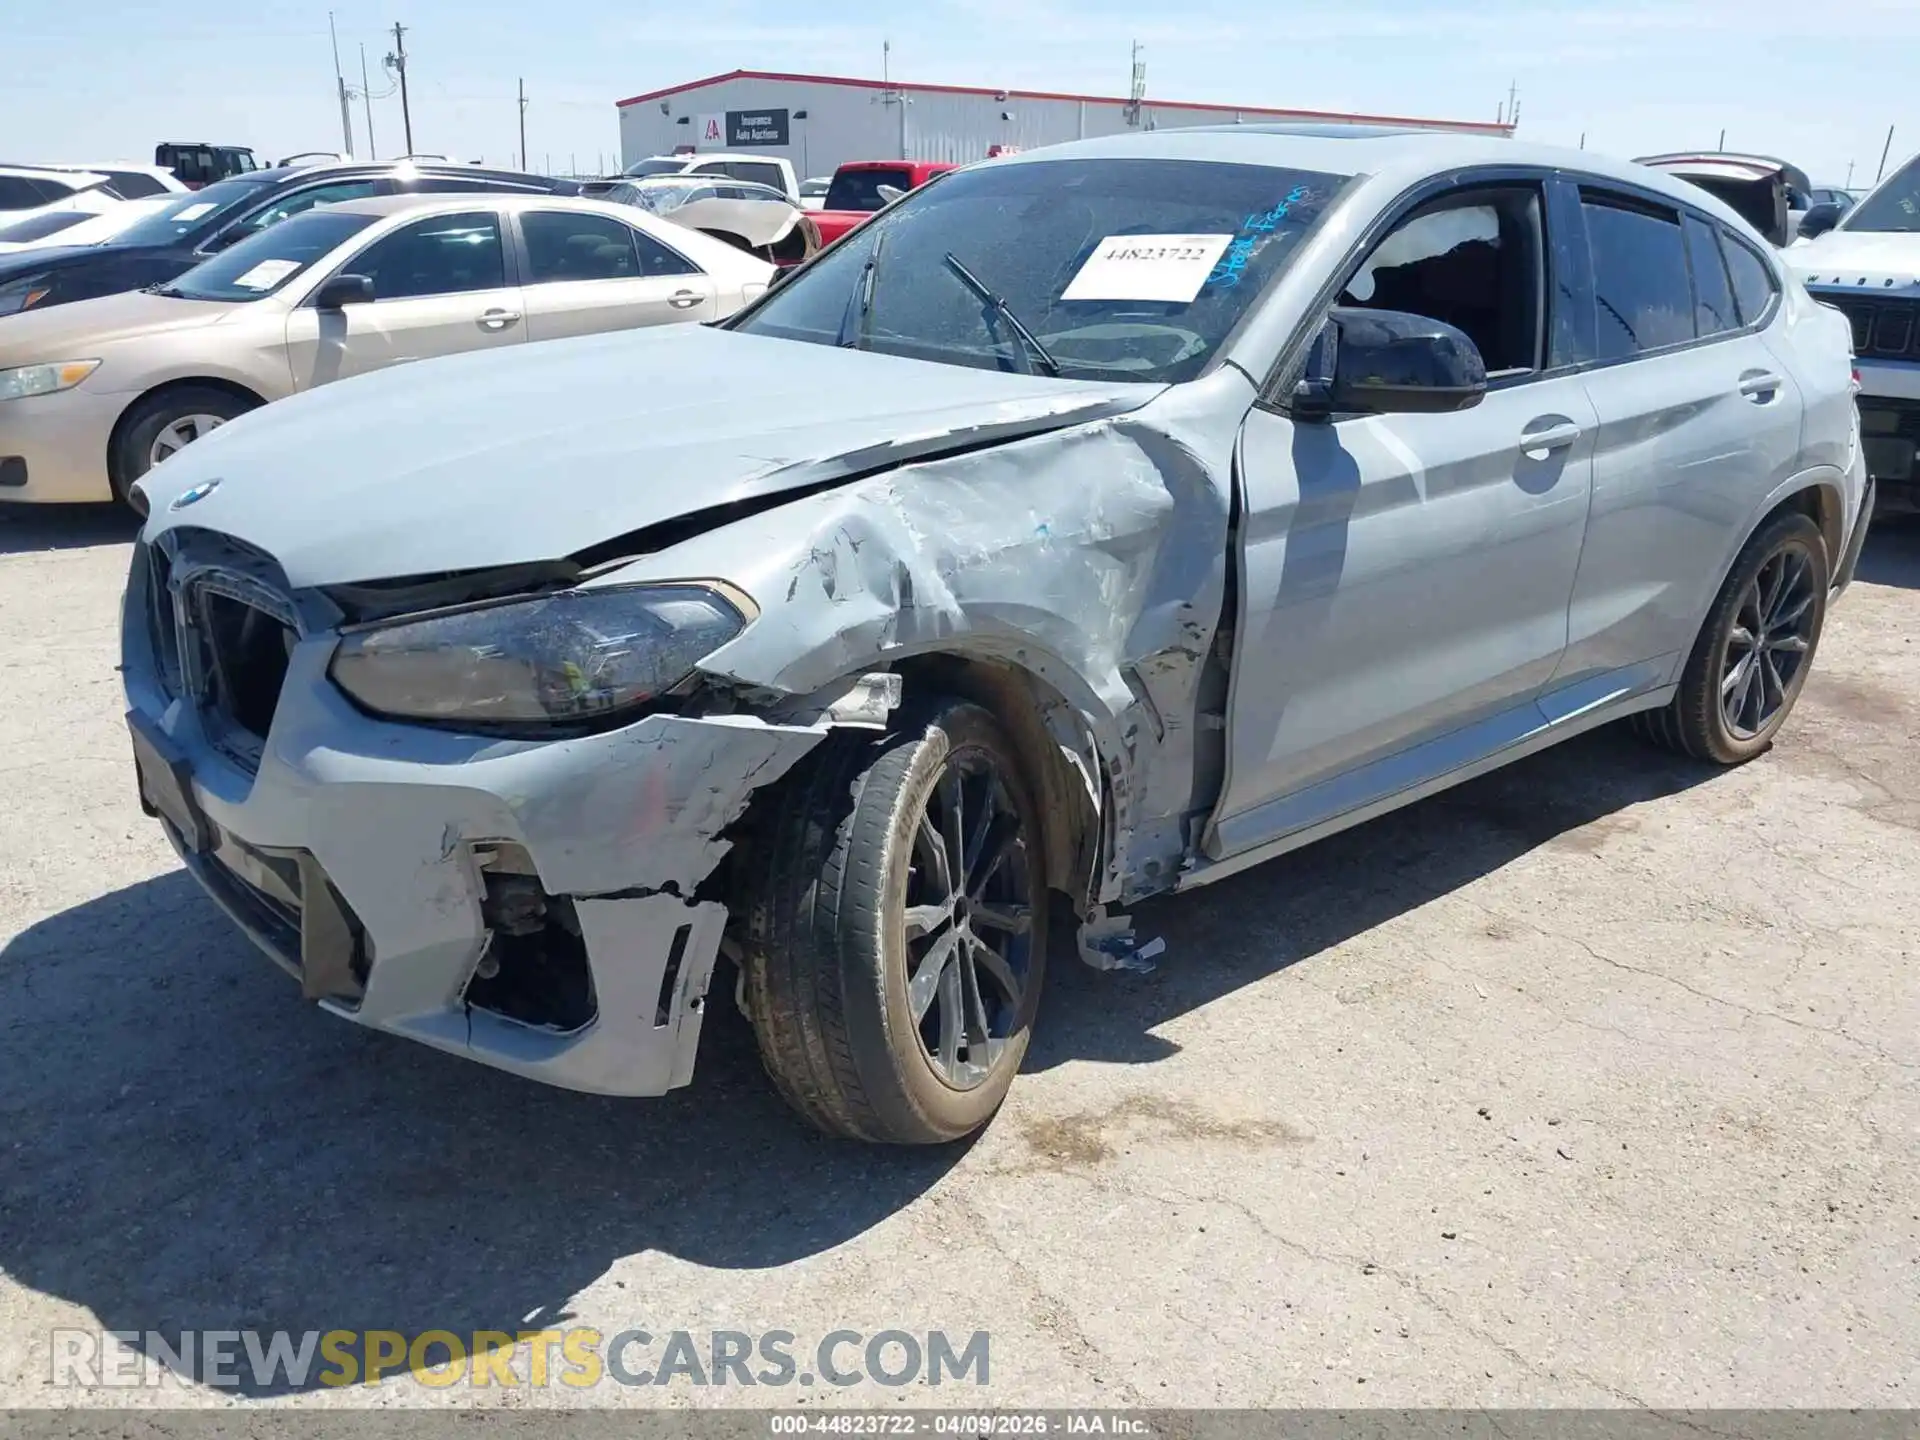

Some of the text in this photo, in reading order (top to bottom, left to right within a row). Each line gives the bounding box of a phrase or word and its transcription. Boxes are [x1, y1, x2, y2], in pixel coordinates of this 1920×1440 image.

[741, 113, 772, 125] Insurance
[735, 127, 778, 140] Auto Auctions
[1104, 247, 1206, 261] 44823722
